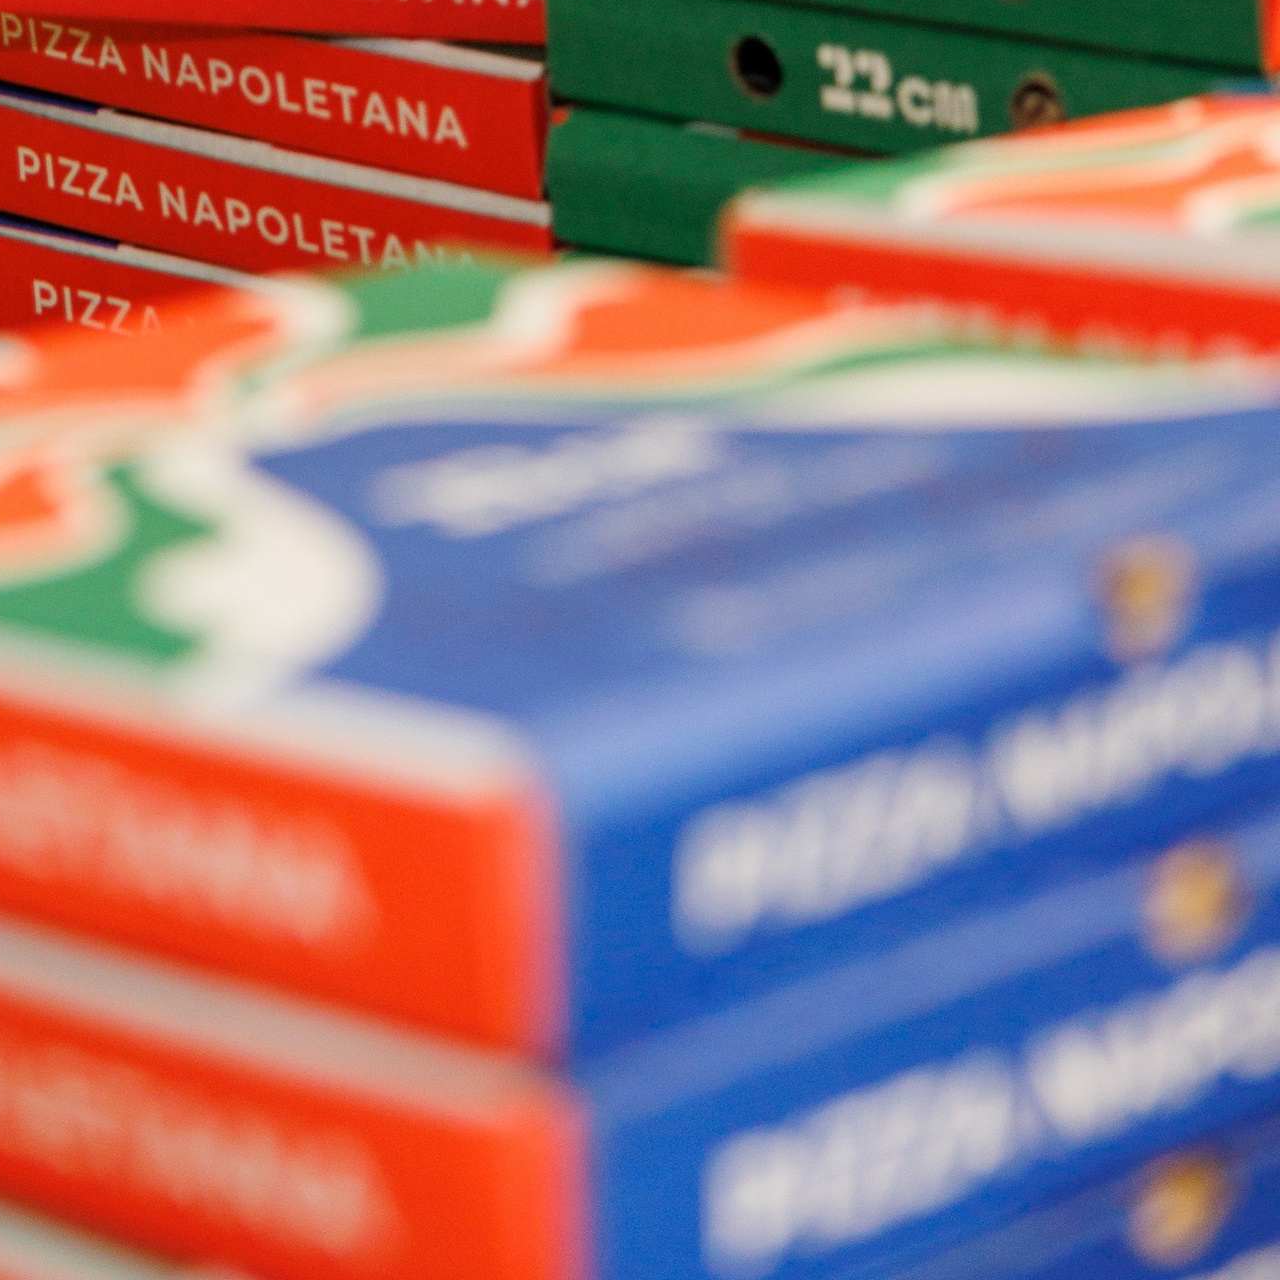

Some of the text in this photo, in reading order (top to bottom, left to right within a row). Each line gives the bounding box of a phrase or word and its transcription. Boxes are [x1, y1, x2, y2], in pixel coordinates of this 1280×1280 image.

[0, 11, 468, 150] PIZZA NAPOLETANA
[18, 146, 144, 212] PIZZA
[33, 278, 163, 336] PIZZA
